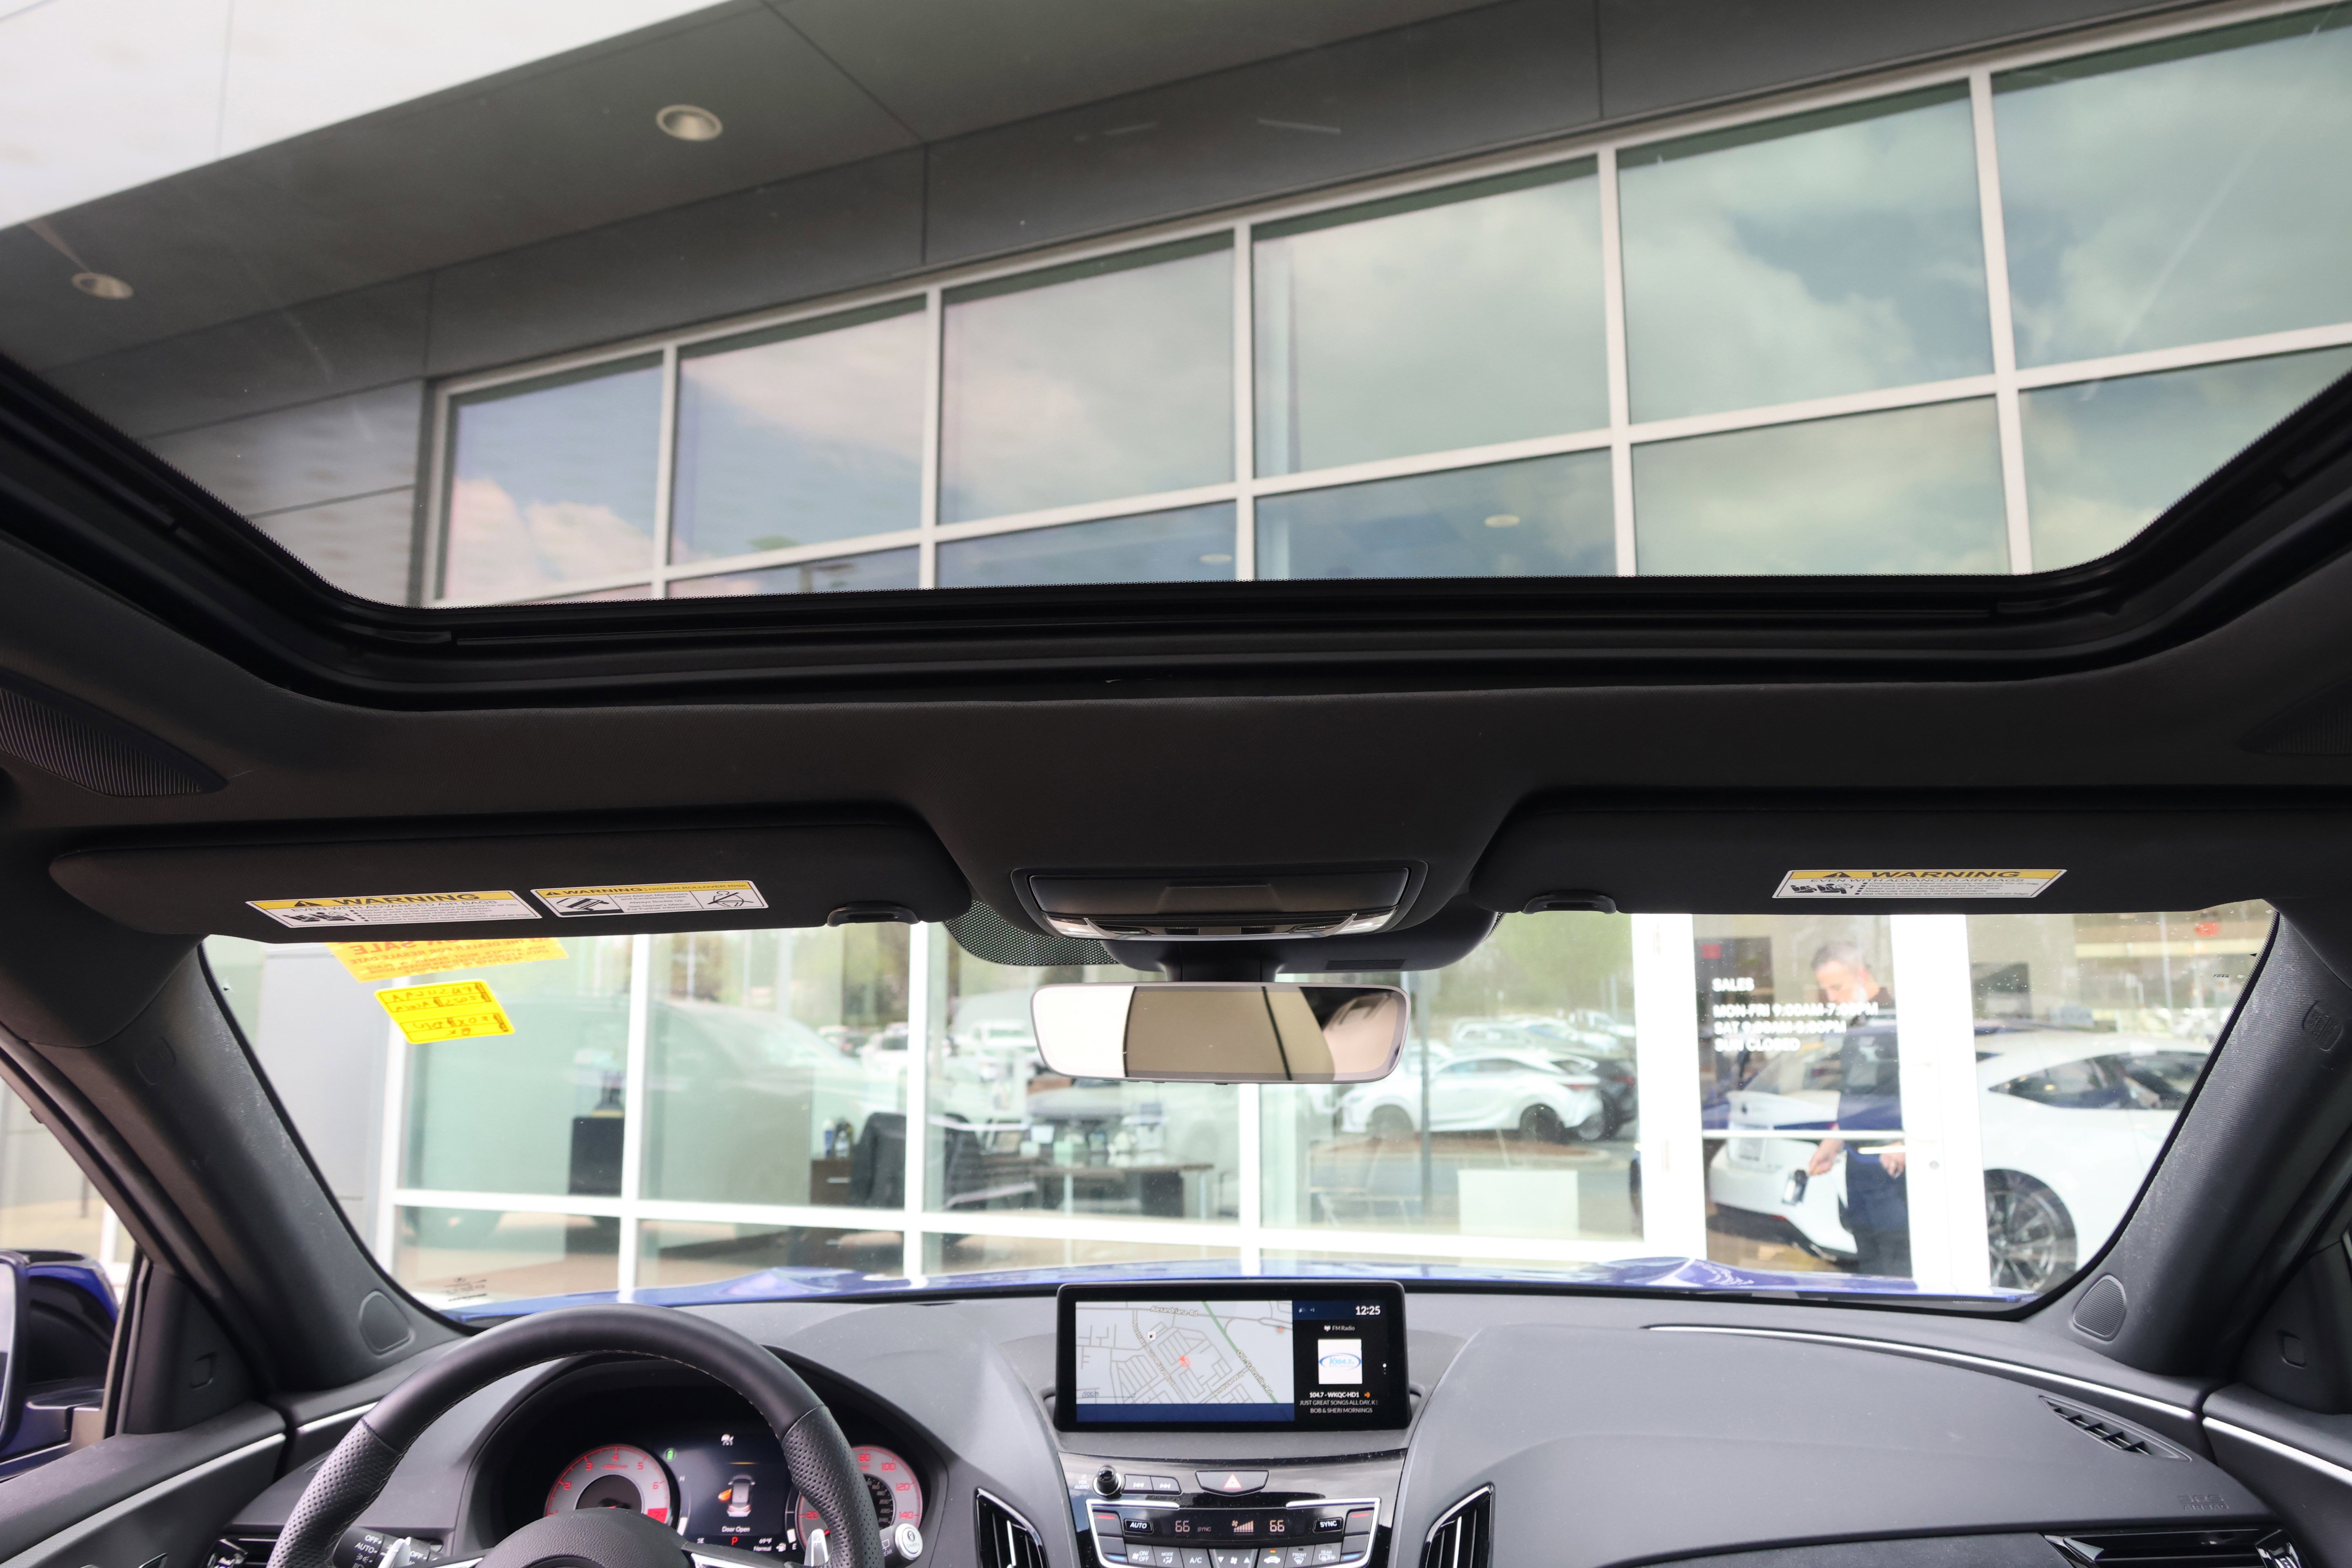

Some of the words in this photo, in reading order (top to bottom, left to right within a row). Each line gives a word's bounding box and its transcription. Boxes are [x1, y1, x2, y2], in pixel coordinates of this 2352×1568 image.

[332, 894, 479, 905] WARNING
[1712, 977, 1755, 992] SALES
[1713, 1003, 1770, 1018] MON-FRI
[1714, 1021, 1740, 1035] SAT
[1715, 1038, 1744, 1052] SUN
[1746, 1038, 1801, 1051] CLOSED
[1150, 1306, 1187, 1315] Alexandriana
[1355, 1305, 1381, 1315] 12:25
[1145, 1347, 1155, 1361] Auto
[1154, 1360, 1165, 1374] Plaza
[1165, 1374, 1175, 1387] Blvd
[1237, 1350, 1247, 1361] Old
[1245, 1361, 1266, 1387] Statesville
[1265, 1386, 1274, 1395] Rd
[611, 1453, 619, 1461] 4
[859, 1454, 871, 1462] 80
[586, 1462, 593, 1471] 3
[637, 1462, 644, 1471] 5
[564, 1482, 572, 1490] 2
[652, 1482, 659, 1490] 6
[895, 1483, 910, 1491] 120
[805, 1511, 819, 1520] 20
[1175, 1520, 1190, 1532] 66
[1270, 1520, 1285, 1532] 66
[365, 1535, 379, 1544] OFF
[731, 1537, 738, 1546] P
[354, 1542, 375, 1554] AUTO
[410, 1550, 423, 1559] OFF
